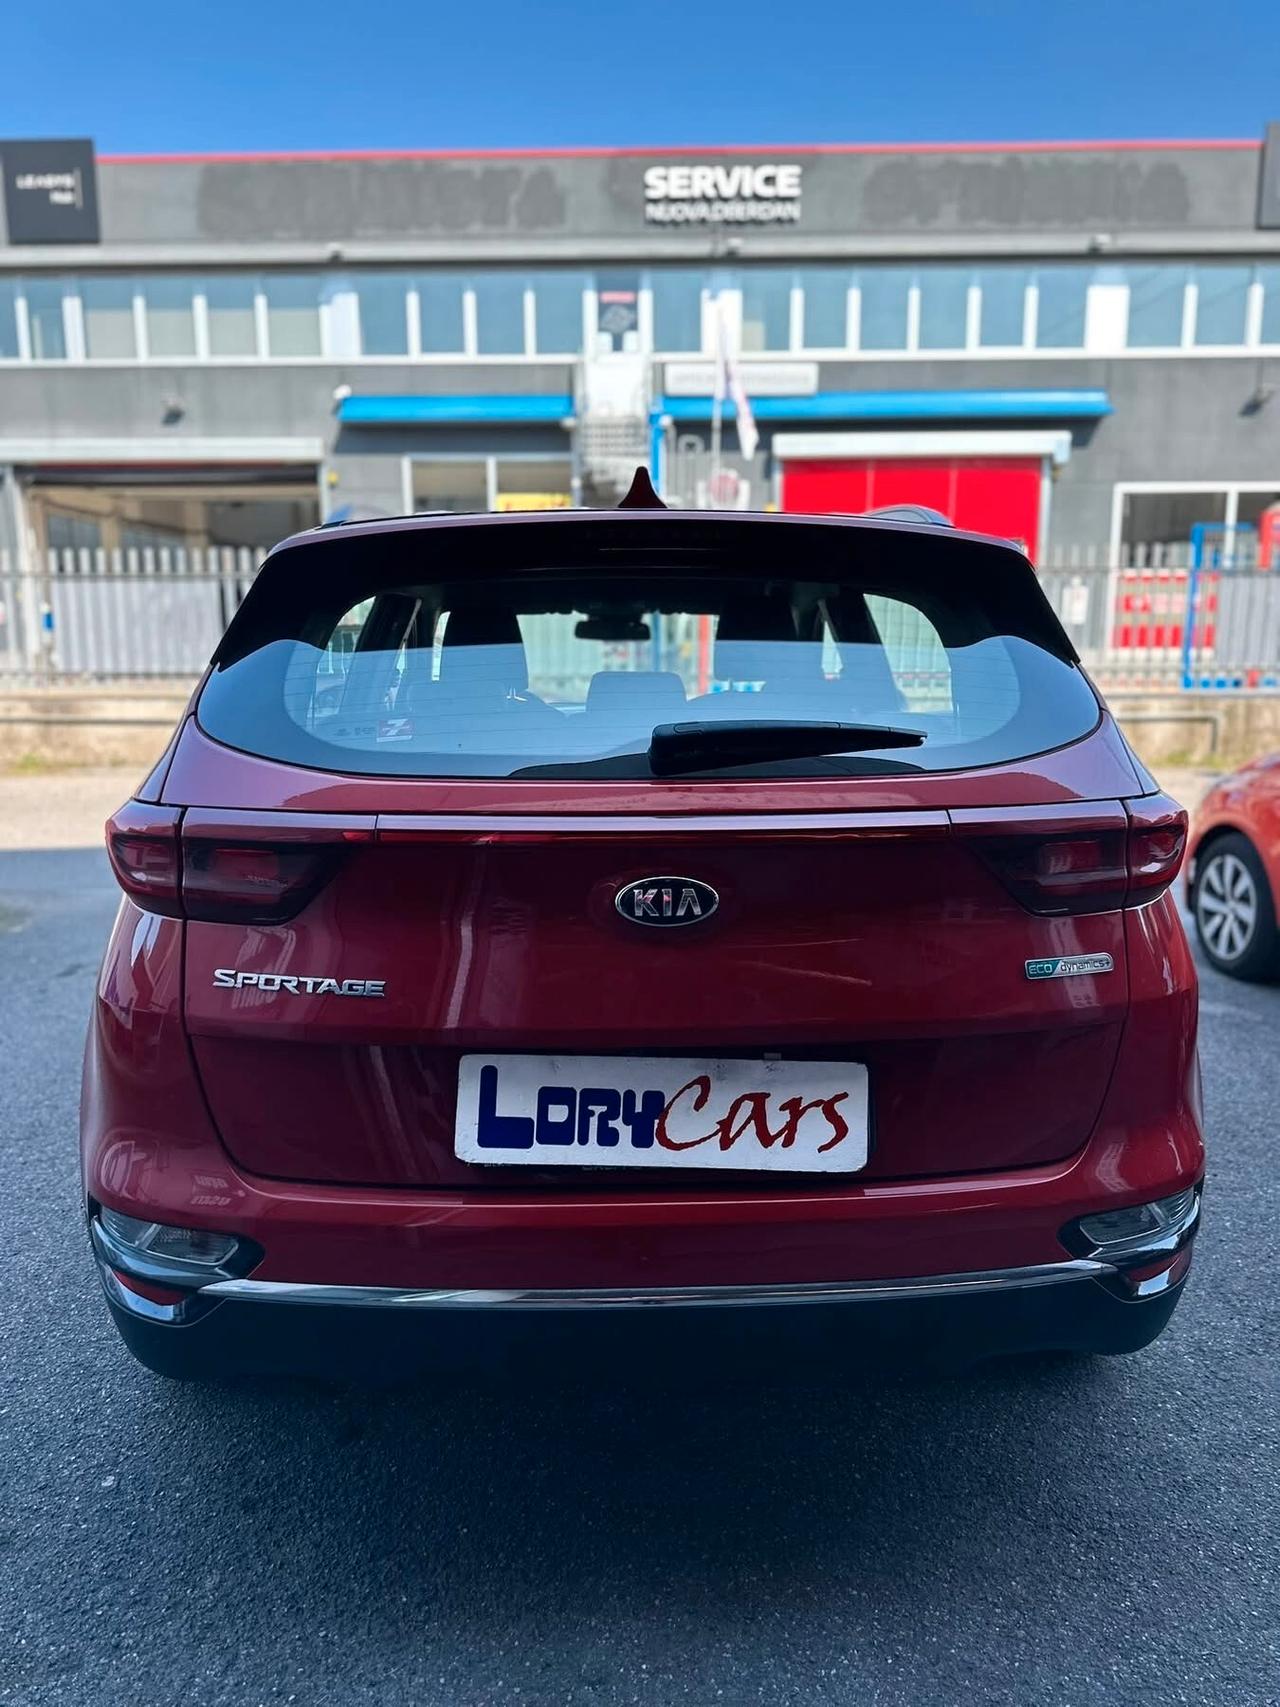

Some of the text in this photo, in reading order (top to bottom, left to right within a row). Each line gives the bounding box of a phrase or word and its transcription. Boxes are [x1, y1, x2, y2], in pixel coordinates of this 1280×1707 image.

[644, 165, 803, 199] SERVICE
[633, 888, 702, 917] KIA
[212, 968, 387, 997] SPORTAGE
